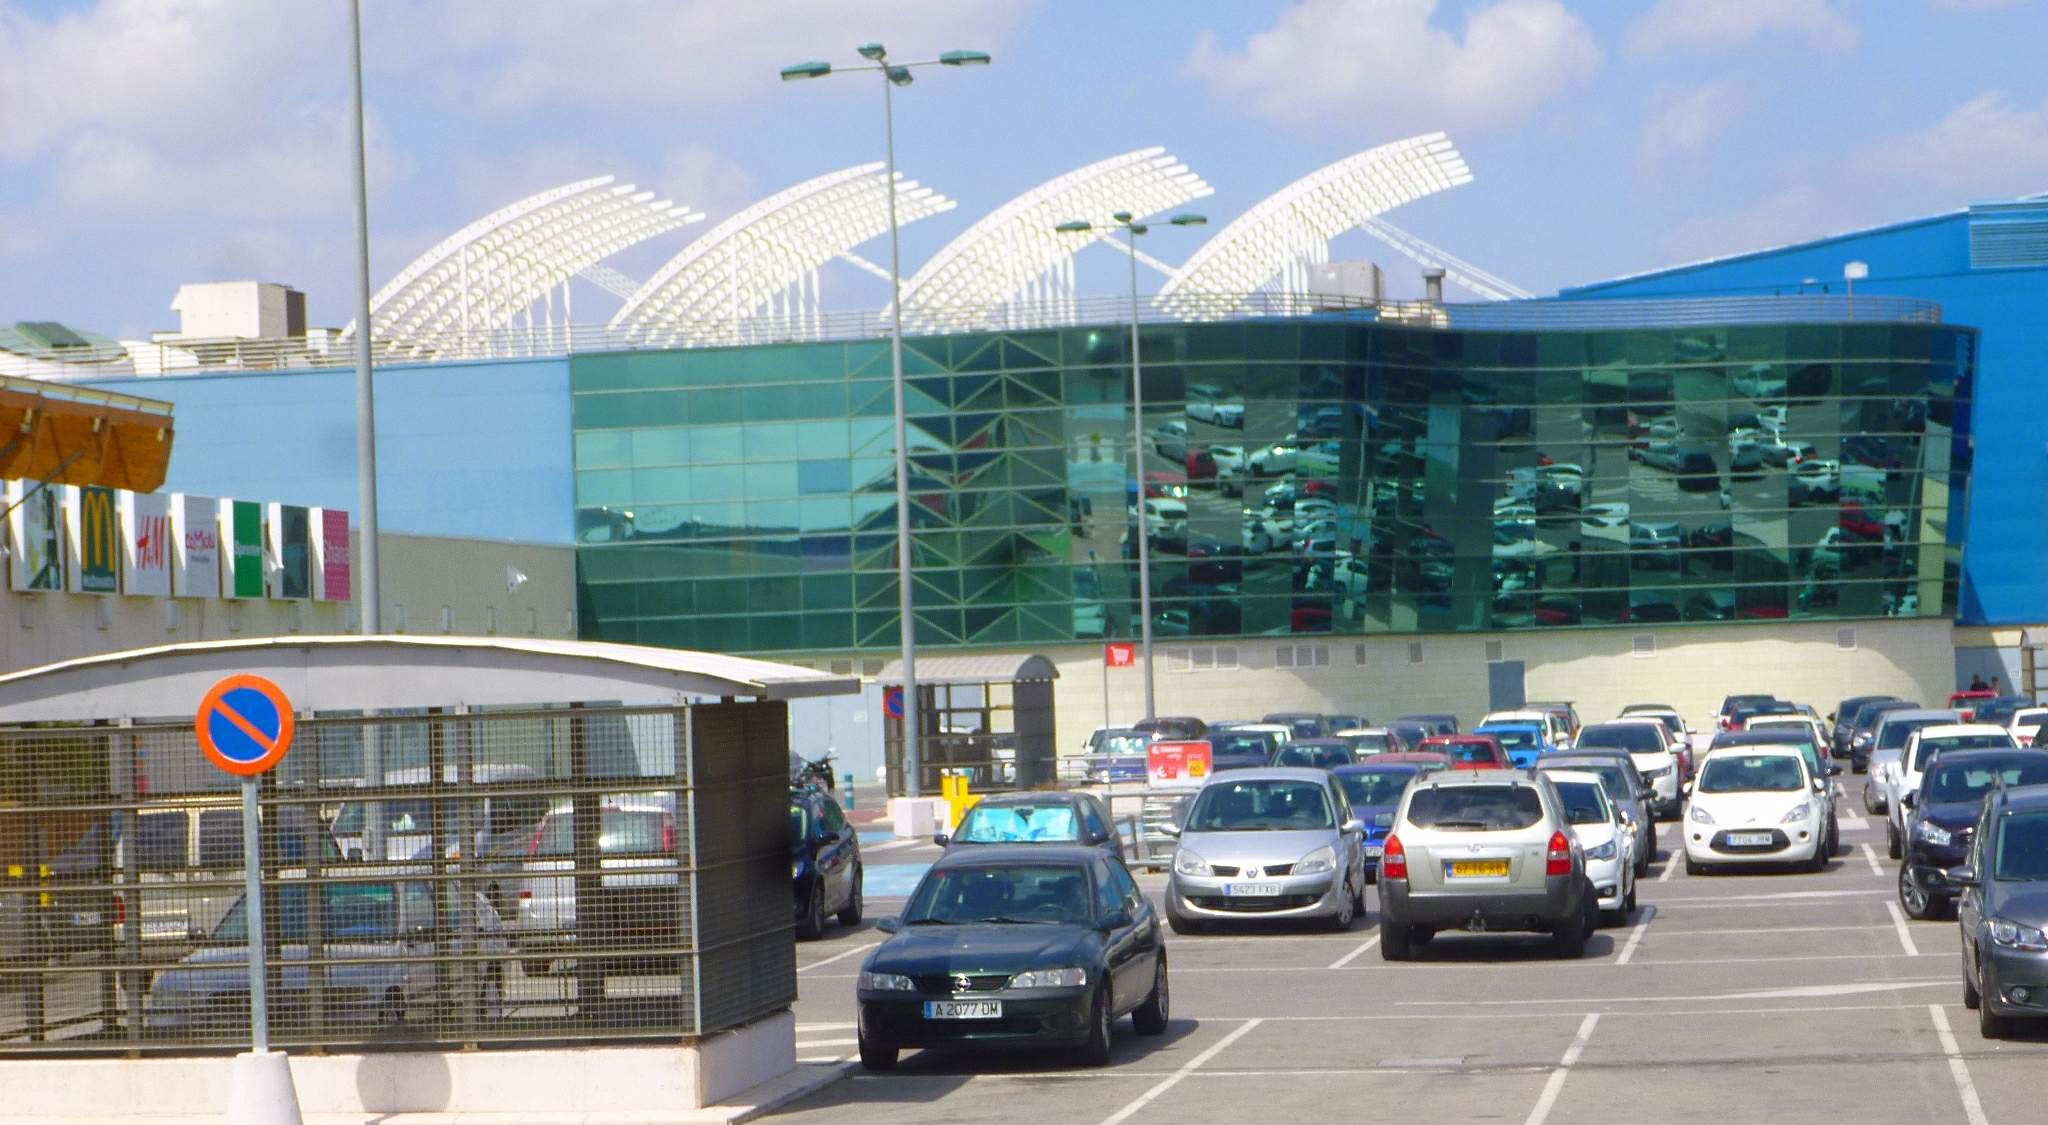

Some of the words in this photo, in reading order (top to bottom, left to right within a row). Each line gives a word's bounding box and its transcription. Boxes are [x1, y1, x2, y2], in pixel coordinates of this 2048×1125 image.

[935, 1003, 943, 1016] A
[946, 1003, 978, 1016] 2077
[981, 1002, 998, 1016] DM
